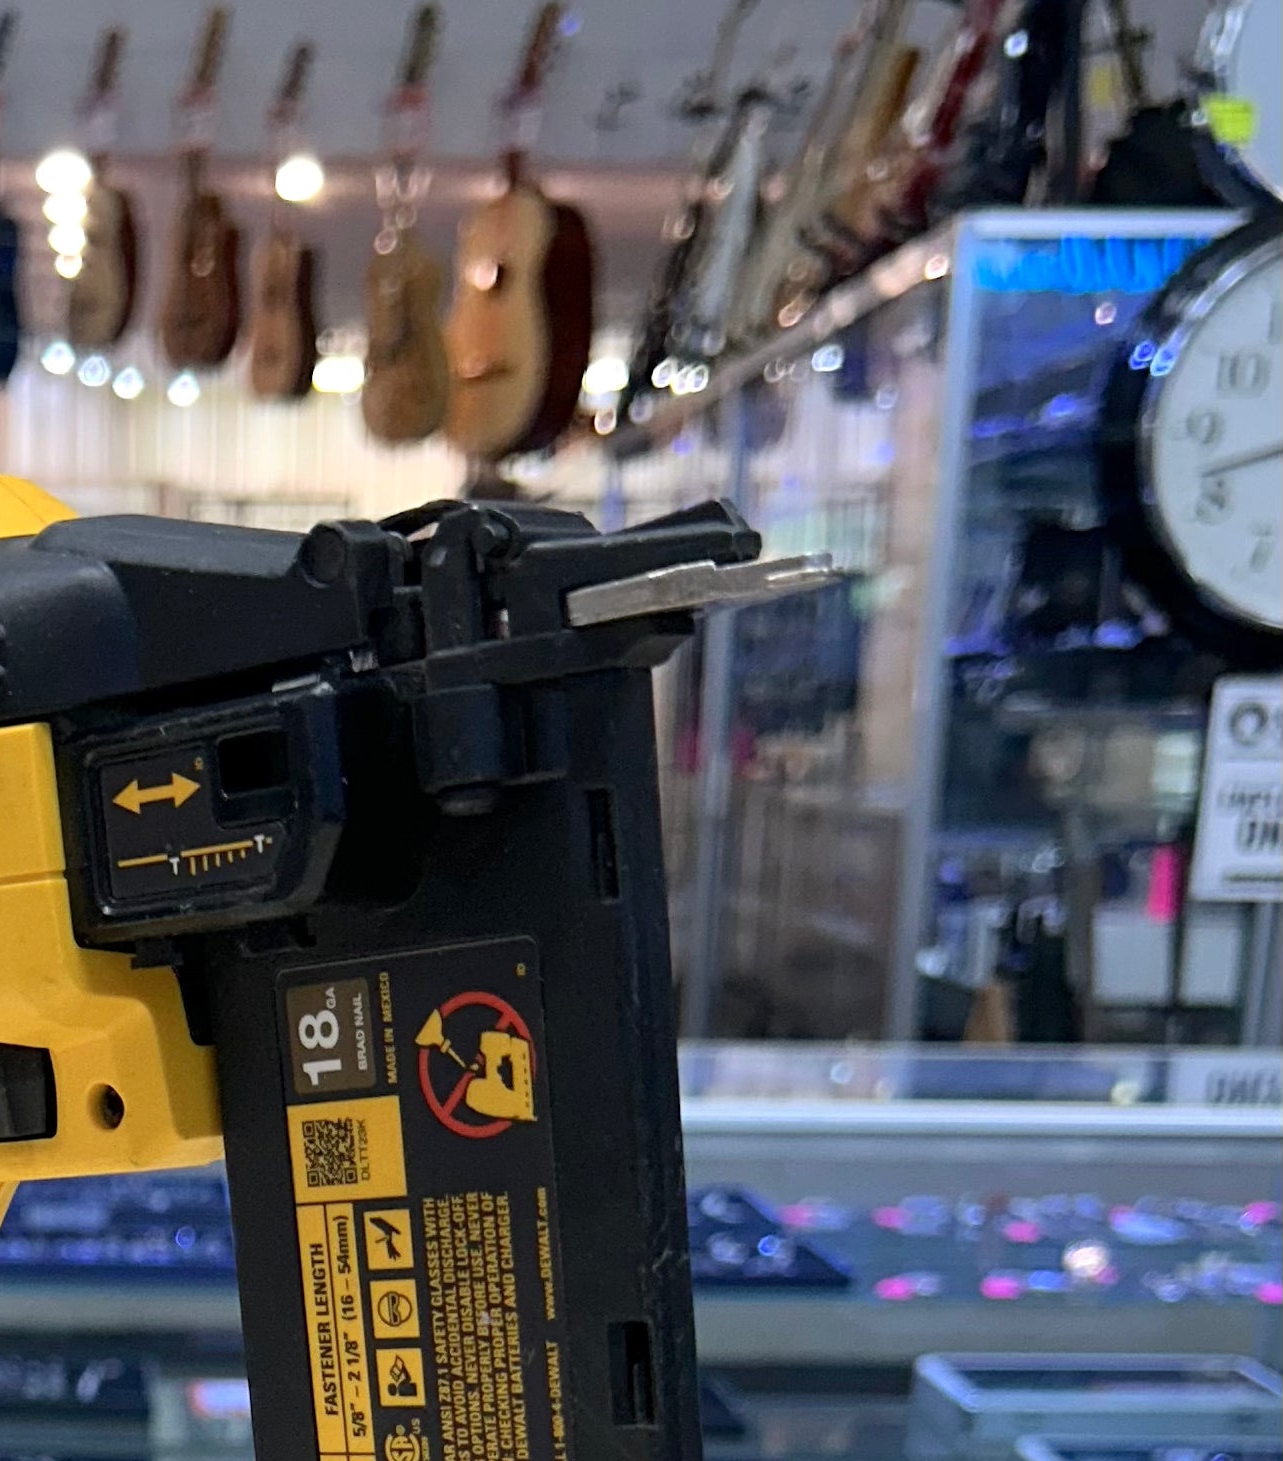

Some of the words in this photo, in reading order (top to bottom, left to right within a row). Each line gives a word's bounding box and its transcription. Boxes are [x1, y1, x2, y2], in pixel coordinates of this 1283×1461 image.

[352, 993, 364, 1026] NAIL
[379, 971, 392, 1022] MEXICO
[298, 1010, 341, 1085] 18
[325, 986, 336, 1009] GA
[355, 1029, 368, 1070] BRAD
[384, 1027, 394, 1042] IN
[385, 1046, 397, 1083] MADE
[422, 1197, 437, 1238] WITH
[466, 1192, 481, 1241] NEVER
[479, 1192, 494, 1212] OF
[332, 1215, 351, 1274] 54mm)
[482, 1216, 501, 1304] OPERATION
[310, 1243, 329, 1316] LENGTH
[426, 1240, 443, 1306] GLASSES
[502, 1272, 516, 1308] AND
[340, 1294, 357, 1321] (16
[457, 1270, 474, 1332] DISABLE
[431, 1310, 448, 1363] SAFETY
[445, 1287, 463, 1376] ACCIDENTAL
[489, 1307, 506, 1368] PROPER
[505, 1311, 523, 1393] BATTERIES
[317, 1322, 338, 1415] FASTENER
[347, 1370, 361, 1381] 2
[462, 1335, 478, 1383] NEVER
[478, 1340, 495, 1412] PROPERLY
[440, 1405, 454, 1441] ANSI
[452, 1380, 467, 1424] AVOID
[495, 1372, 513, 1449] CHECKING
[456, 1427, 469, 1446] TO
[511, 1398, 529, 1459] DEWALT
